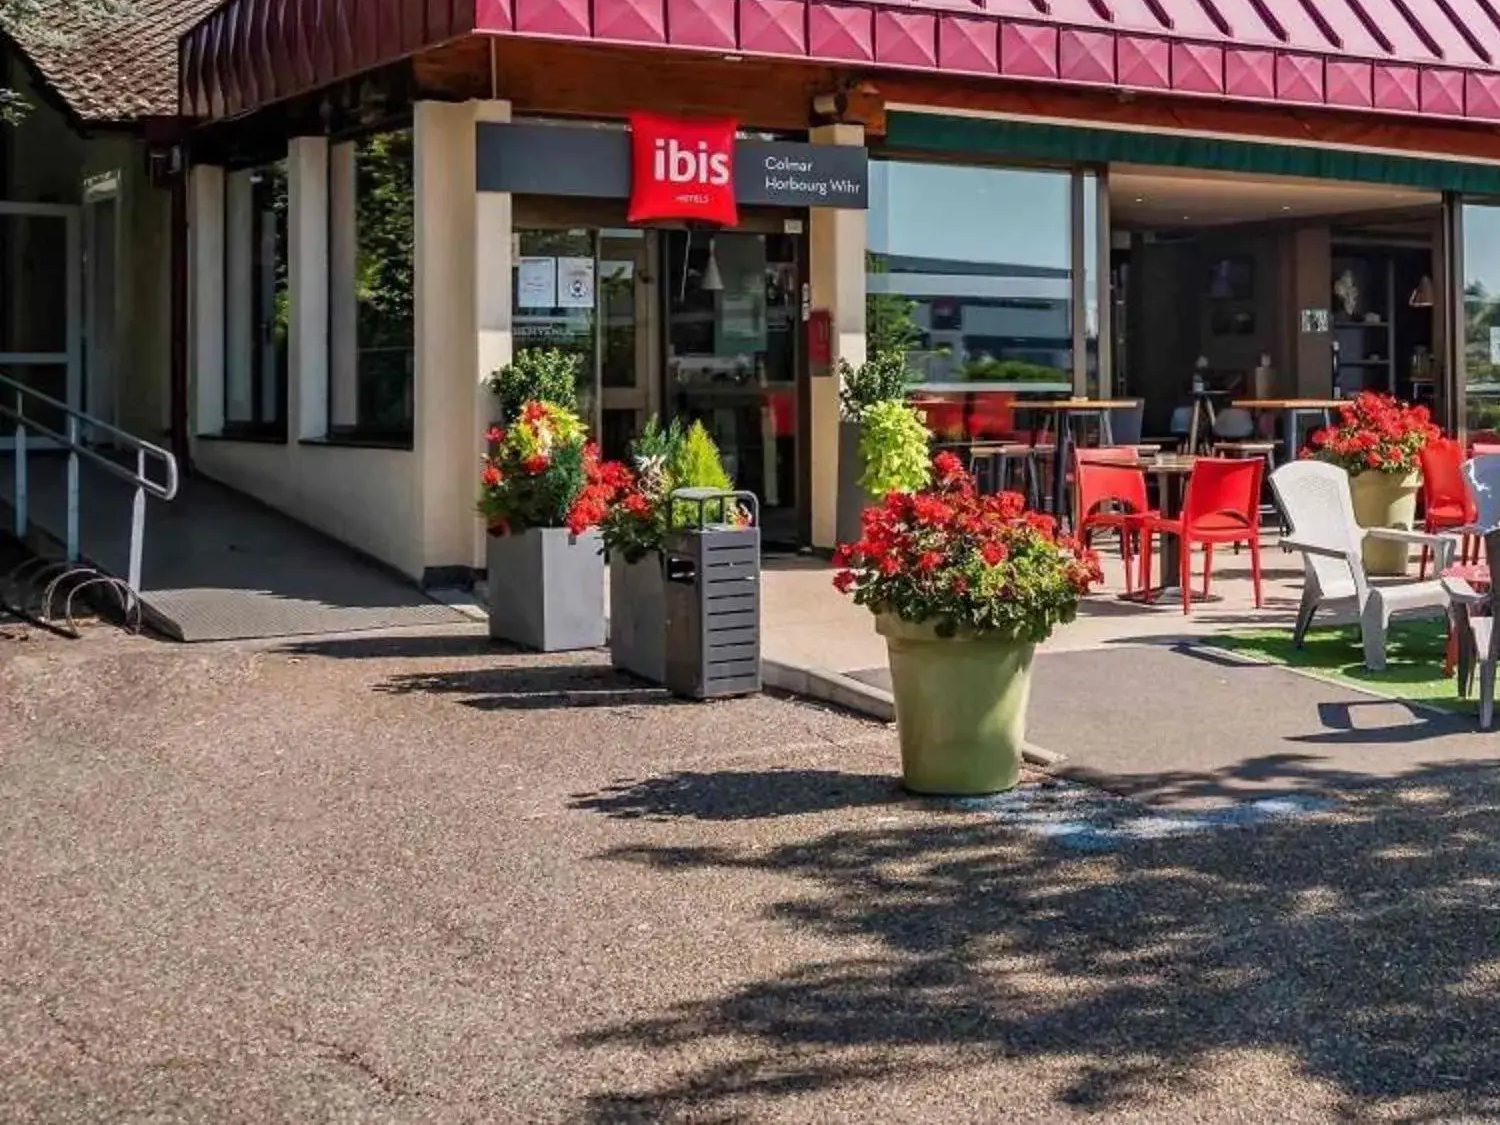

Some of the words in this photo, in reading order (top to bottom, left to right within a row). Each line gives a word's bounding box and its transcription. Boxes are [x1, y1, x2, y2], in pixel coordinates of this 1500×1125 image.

[654, 137, 731, 186] ibis
[764, 156, 815, 173] Colmar
[764, 175, 828, 196] Horbourg
[829, 178, 861, 195] Wihr
